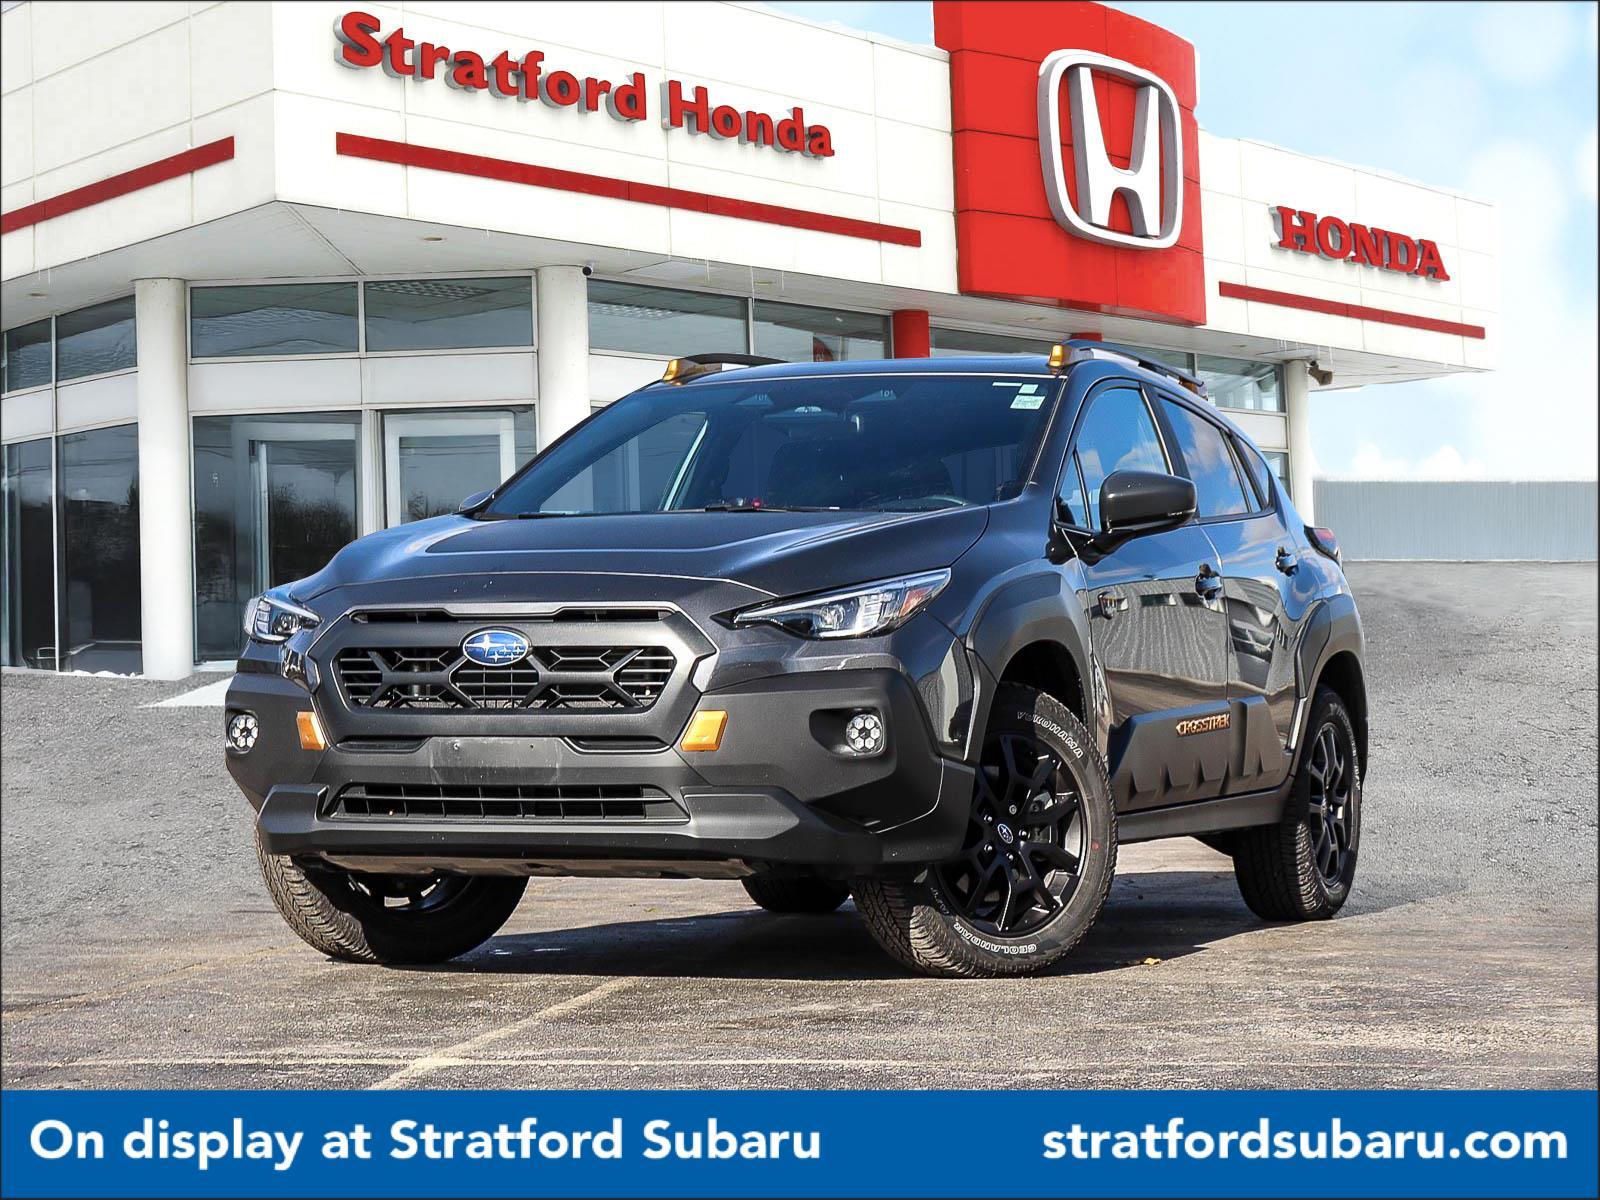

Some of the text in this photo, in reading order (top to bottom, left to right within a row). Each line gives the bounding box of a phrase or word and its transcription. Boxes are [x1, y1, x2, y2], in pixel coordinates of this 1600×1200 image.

[335, 11, 835, 158] Stratford Honda
[1270, 205, 1450, 282] HONDA
[1175, 713, 1231, 737] CROSSTREK
[953, 921, 1037, 955] GEOLANDAR
